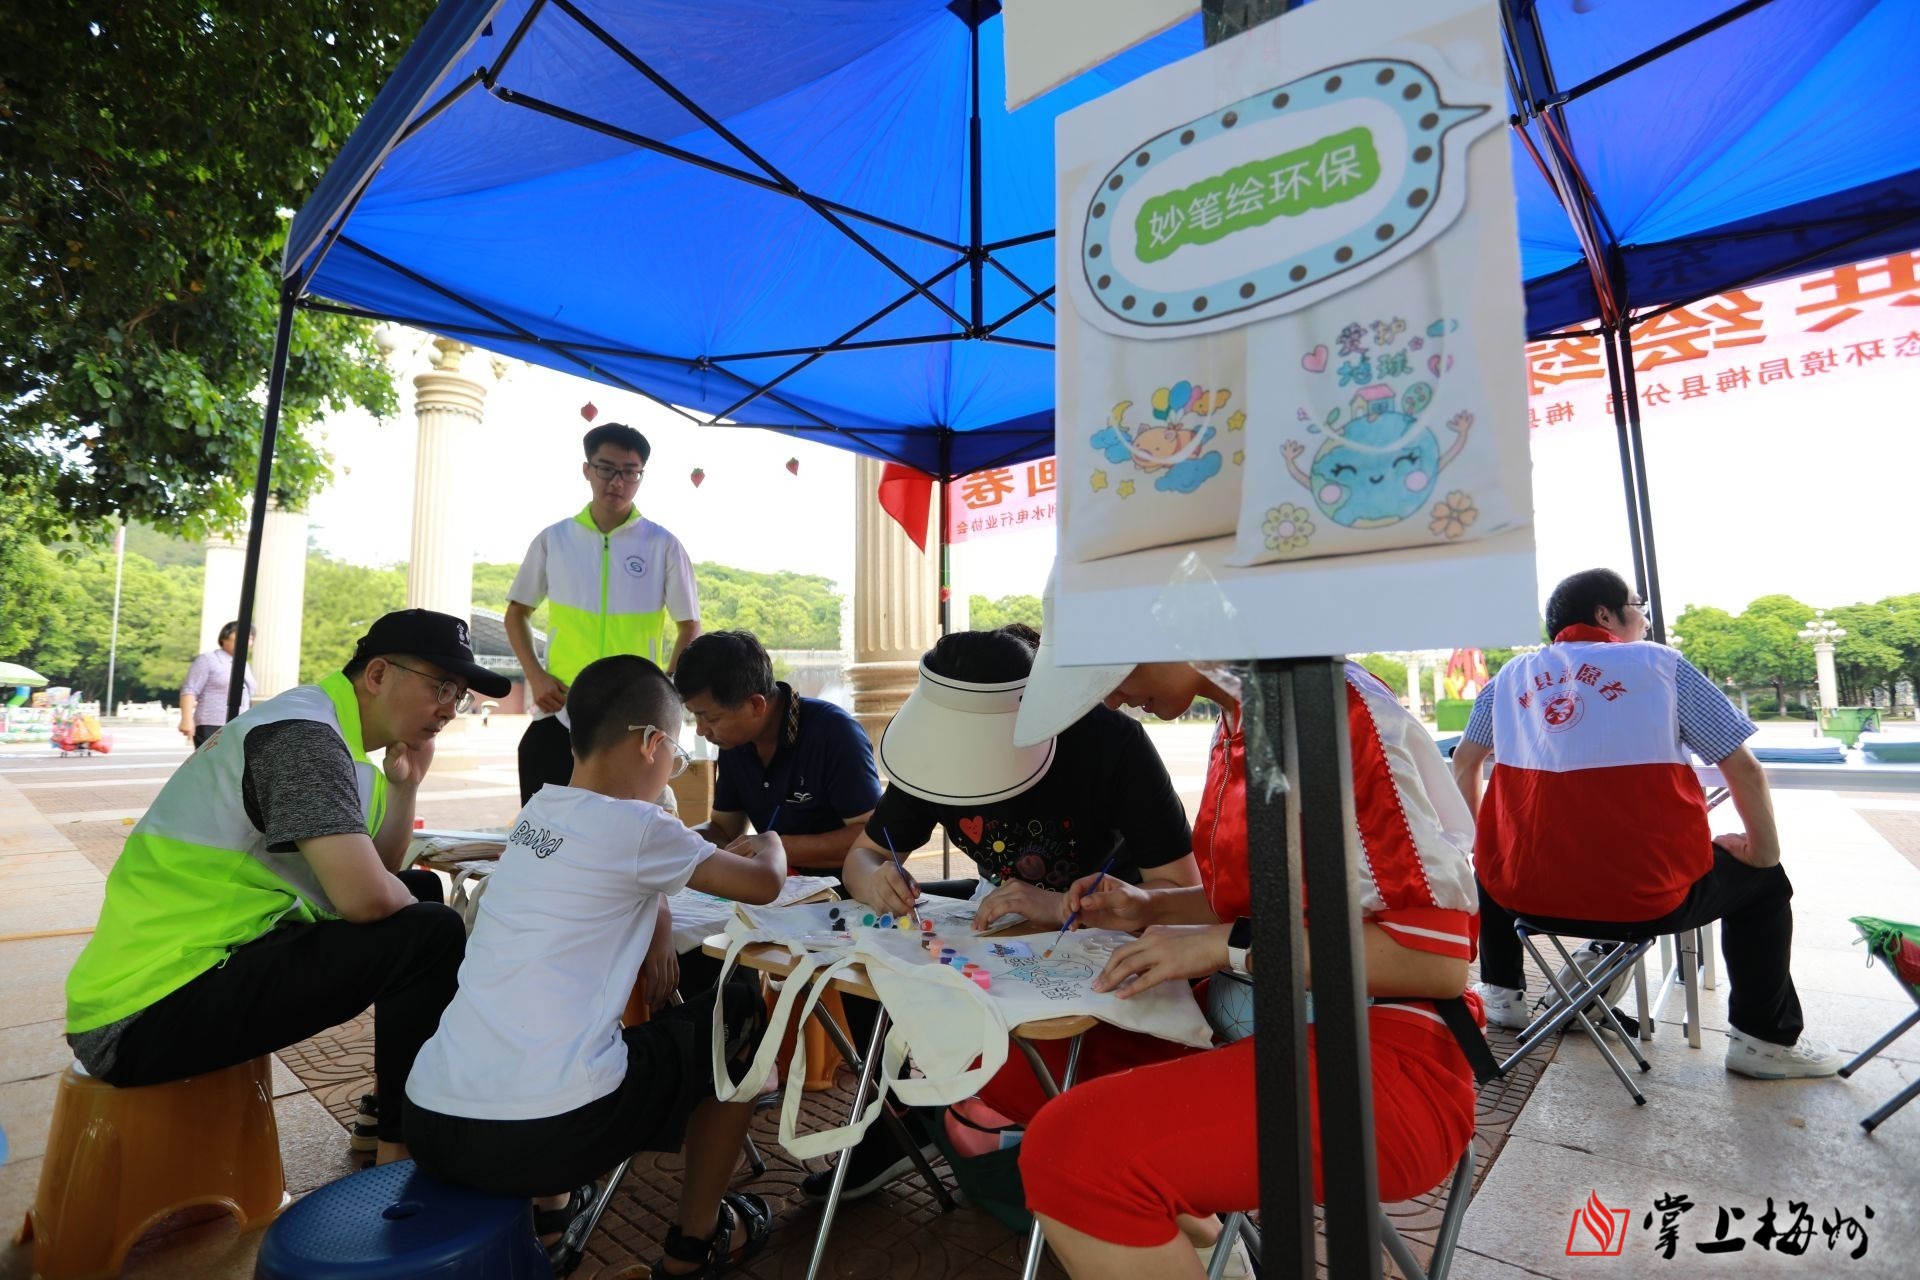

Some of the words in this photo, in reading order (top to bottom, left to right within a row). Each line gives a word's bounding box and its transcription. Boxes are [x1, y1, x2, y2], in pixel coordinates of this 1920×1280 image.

[1148, 144, 1364, 249] 妙笔绘环保
[1335, 316, 1407, 357] 爱护
[1336, 349, 1413, 387] 地球
